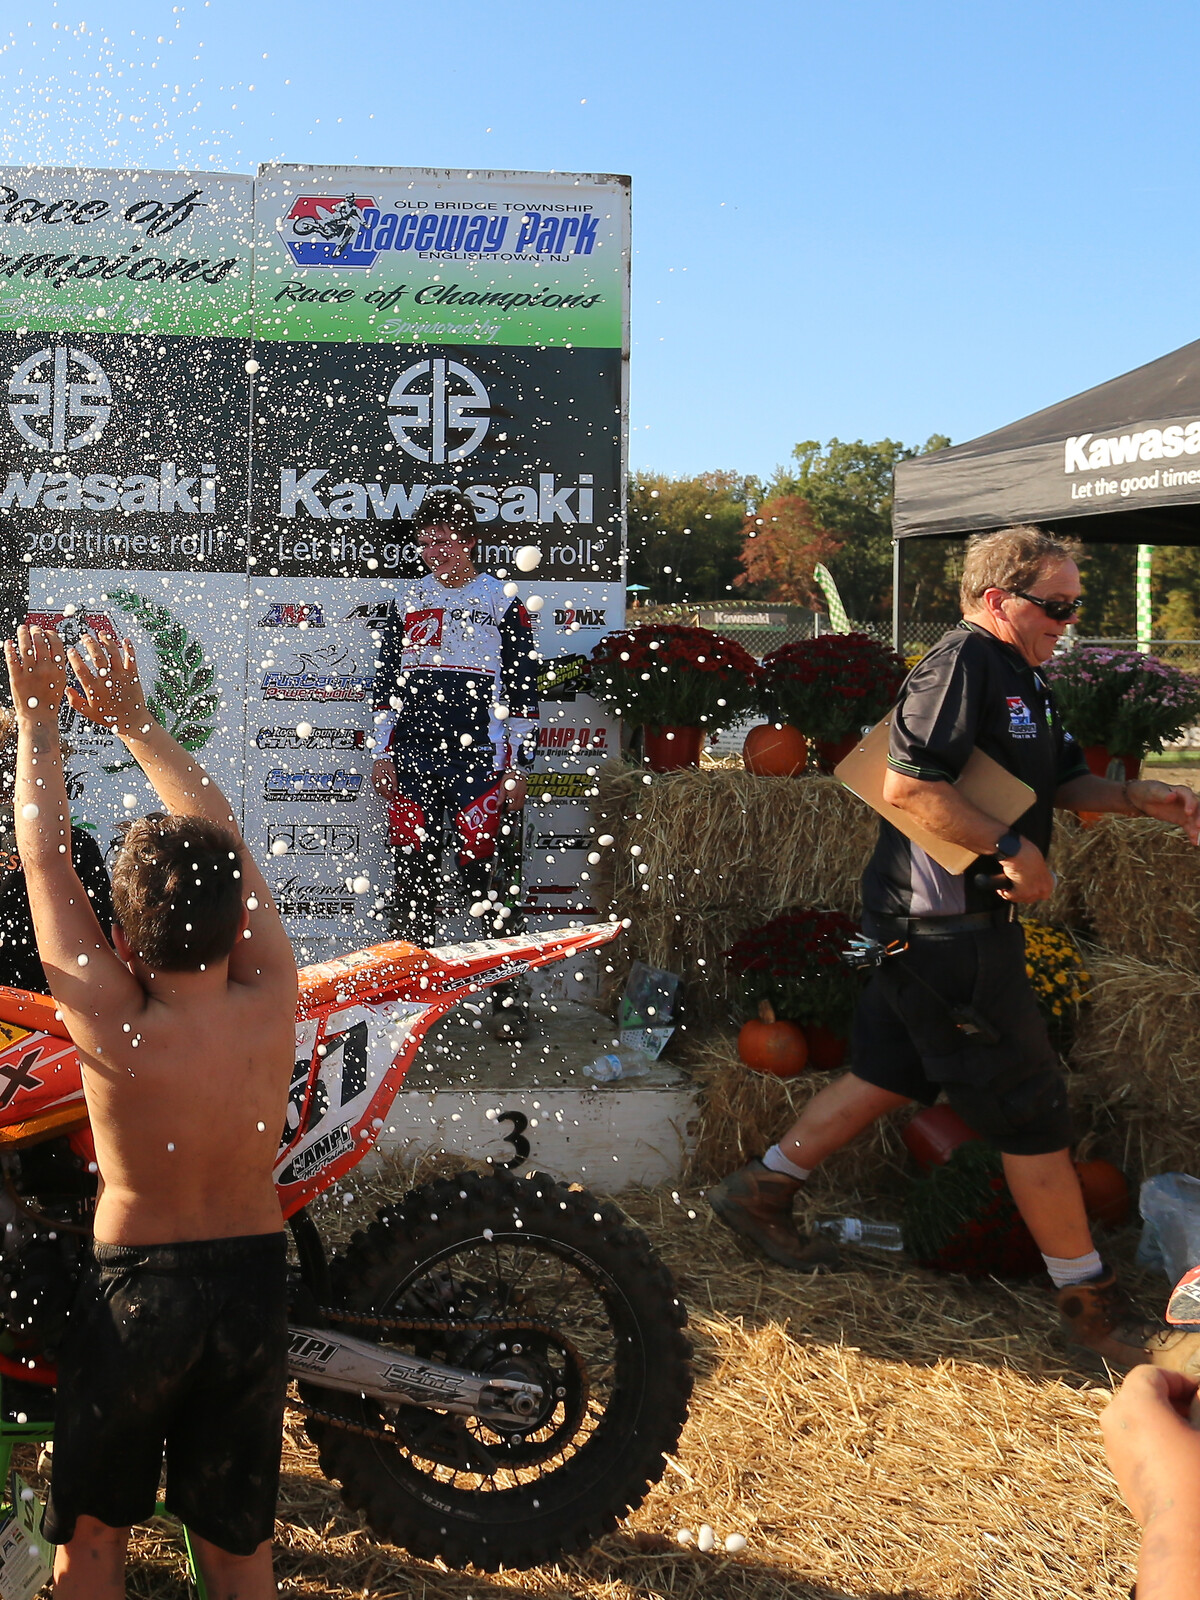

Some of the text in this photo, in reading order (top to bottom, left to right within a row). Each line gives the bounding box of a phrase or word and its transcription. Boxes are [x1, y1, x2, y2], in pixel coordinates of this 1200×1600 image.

[124, 189, 209, 238] of
[394, 200, 594, 213] OLD BRIDGE TOWNSHIP
[353, 208, 600, 255] Raceway Park
[548, 253, 571, 263] NJ
[274, 280, 603, 312] Race of Champions
[377, 318, 473, 337] Sponsored
[1072, 482, 1092, 499] Let
[1095, 478, 1118, 496] the
[1121, 469, 1160, 497] good
[280, 468, 594, 524] Kawsaki
[278, 535, 322, 561] Let
[329, 537, 373, 562] the
[554, 608, 606, 625] D2MX
[714, 611, 770, 625] Kawasaki
[539, 728, 609, 748] AMP OG.
[528, 773, 594, 786] actory
[278, 902, 354, 914] EROES
[497, 1110, 531, 1169] 3
[287, 1332, 339, 1363] MPI
